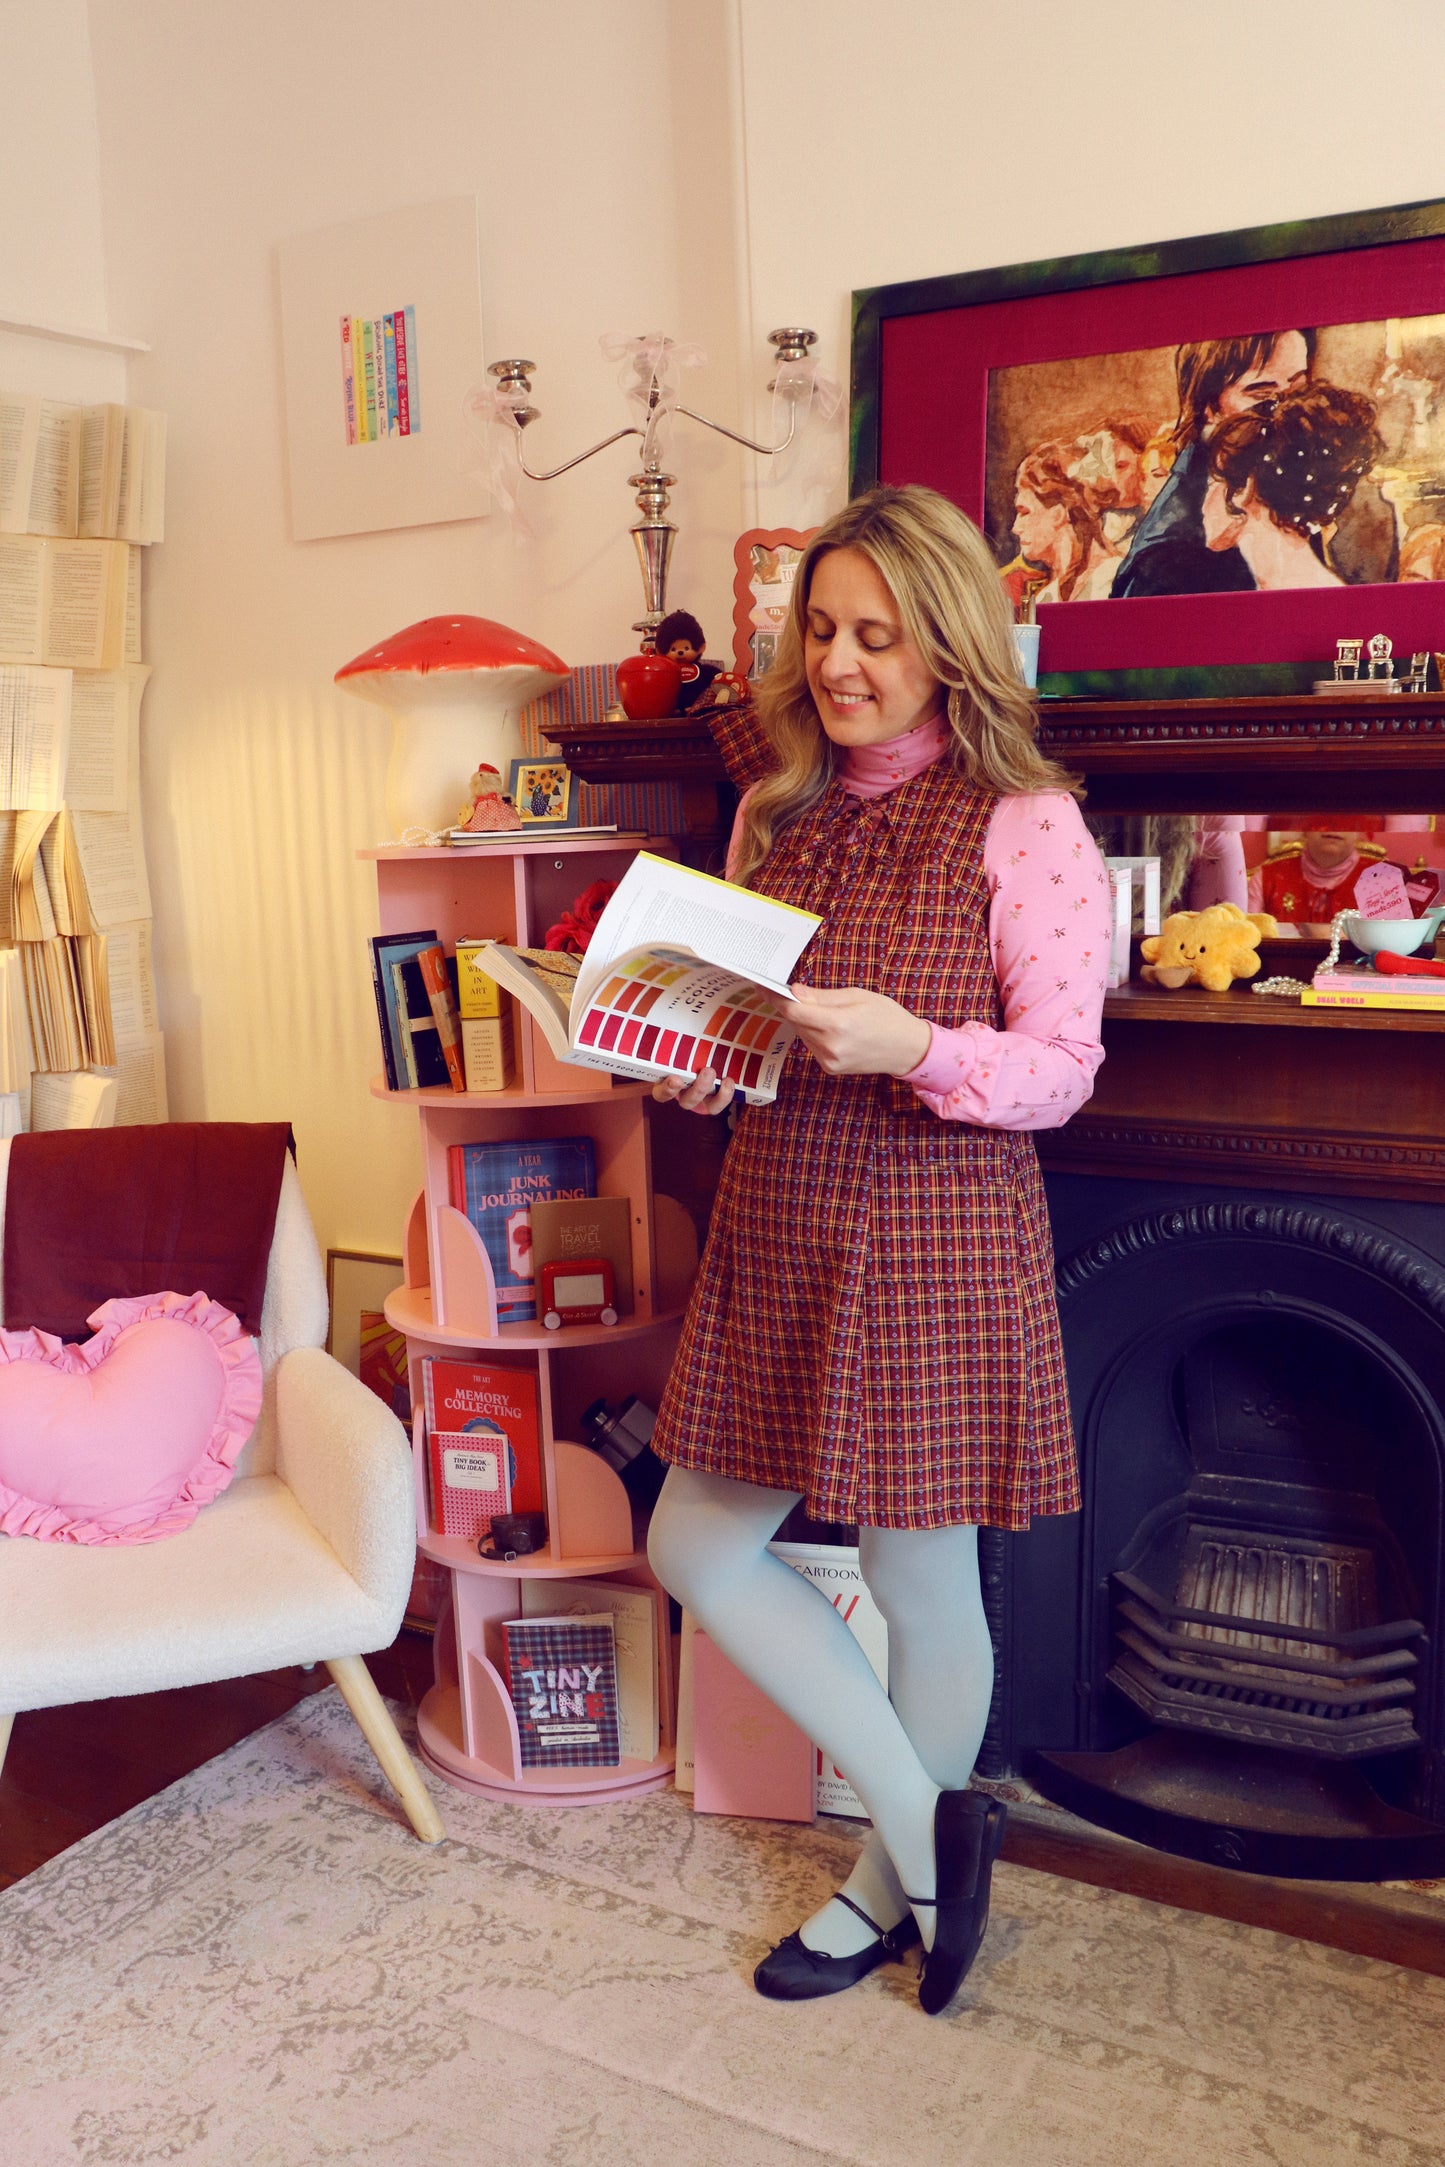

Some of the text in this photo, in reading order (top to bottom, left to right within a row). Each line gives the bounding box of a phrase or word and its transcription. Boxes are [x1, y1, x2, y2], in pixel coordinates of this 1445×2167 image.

[343, 324, 351, 343] RED
[365, 351, 376, 412] WELL MET
[345, 376, 353, 403] ROYAL
[473, 976, 482, 984] IN
[471, 987, 487, 995] ART
[691, 1001, 706, 1014] IN
[1316, 996, 1365, 1005] SNAIL WORLD
[518, 1155, 542, 1167] A YEAR
[509, 1175, 552, 1192] JUNK
[479, 1188, 586, 1211] JOURNALING
[560, 1224, 600, 1235] THE ART OF
[560, 1232, 601, 1245] TRAVEL
[472, 1374, 491, 1384] THE ART
[455, 1388, 510, 1406] MEMORY
[444, 1398, 523, 1419] COLLECTING
[469, 1458, 487, 1466] BOOK
[793, 1565, 864, 1582] ARTOON
[521, 1665, 604, 1694] TINY
[528, 1692, 606, 1719] ZINE
[827, 1782, 848, 1791] DAVID
